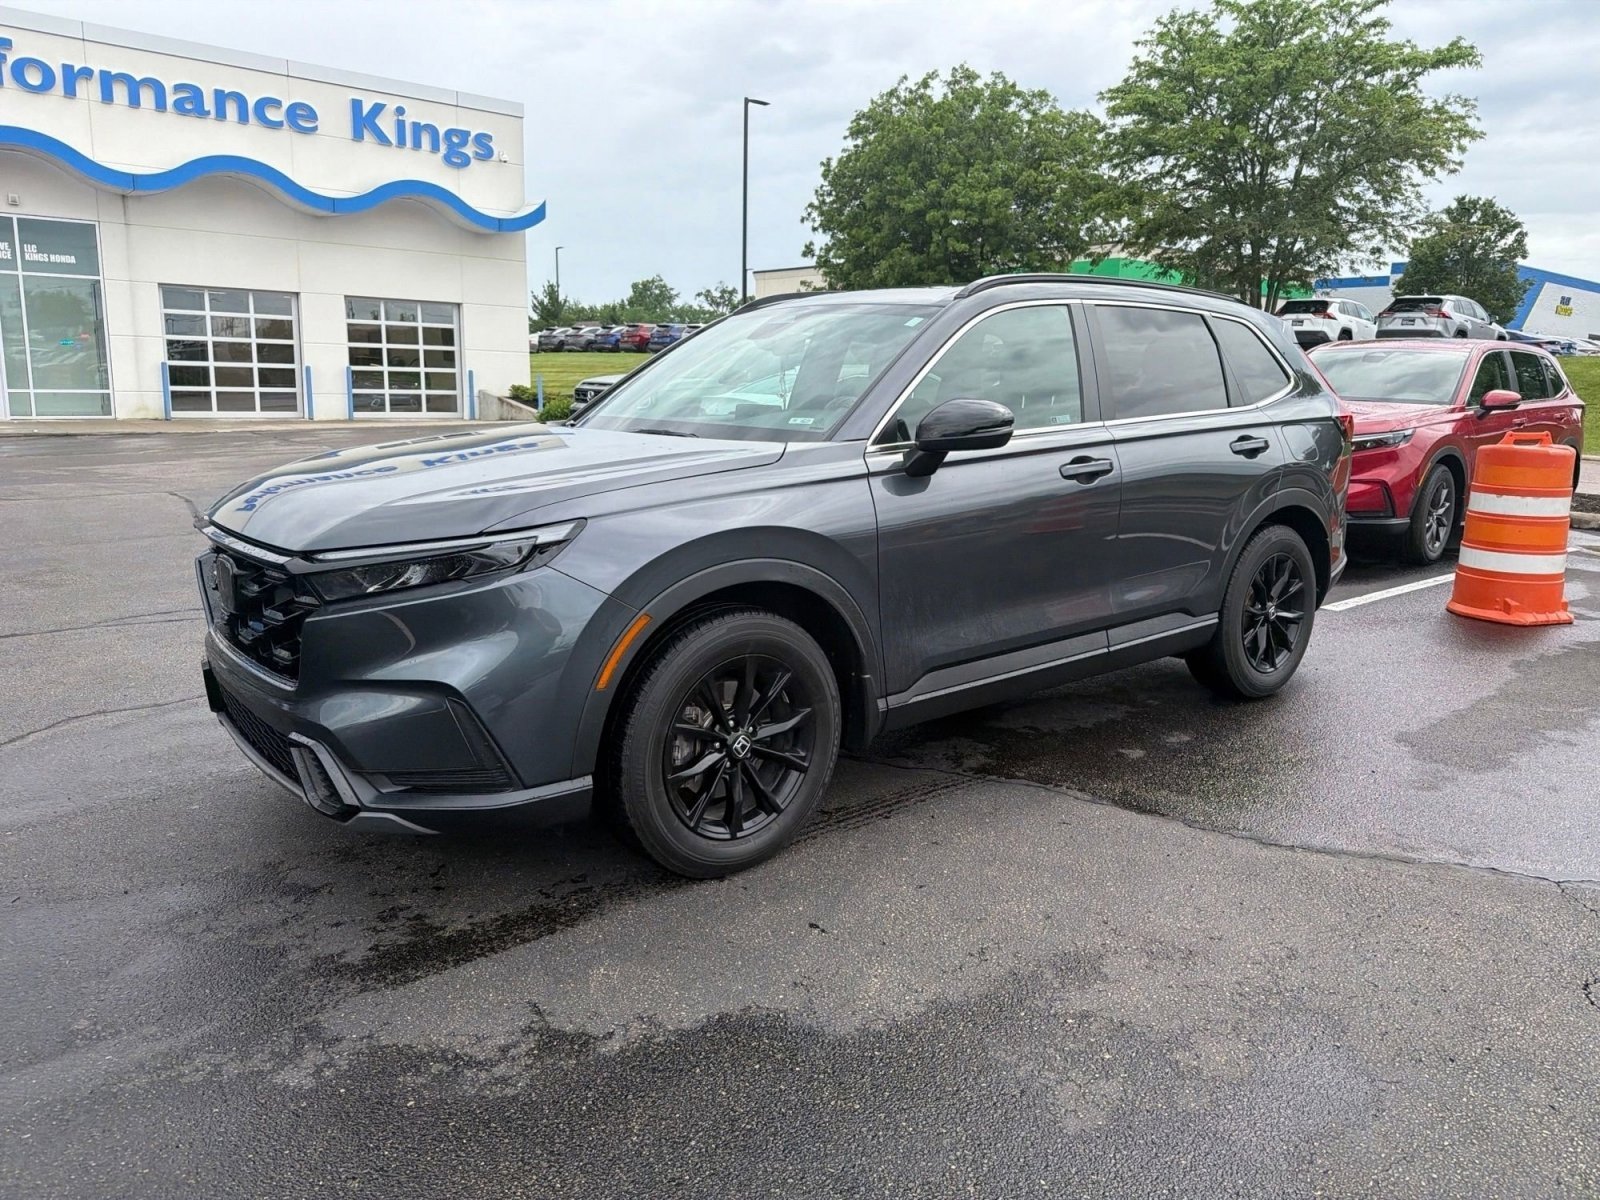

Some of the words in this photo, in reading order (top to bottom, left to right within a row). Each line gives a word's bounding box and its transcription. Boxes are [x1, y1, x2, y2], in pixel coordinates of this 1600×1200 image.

[351, 98, 494, 168] Kings
[24, 244, 37, 252] LLC
[25, 253, 48, 262] KINGS
[49, 254, 76, 264] HONDA
